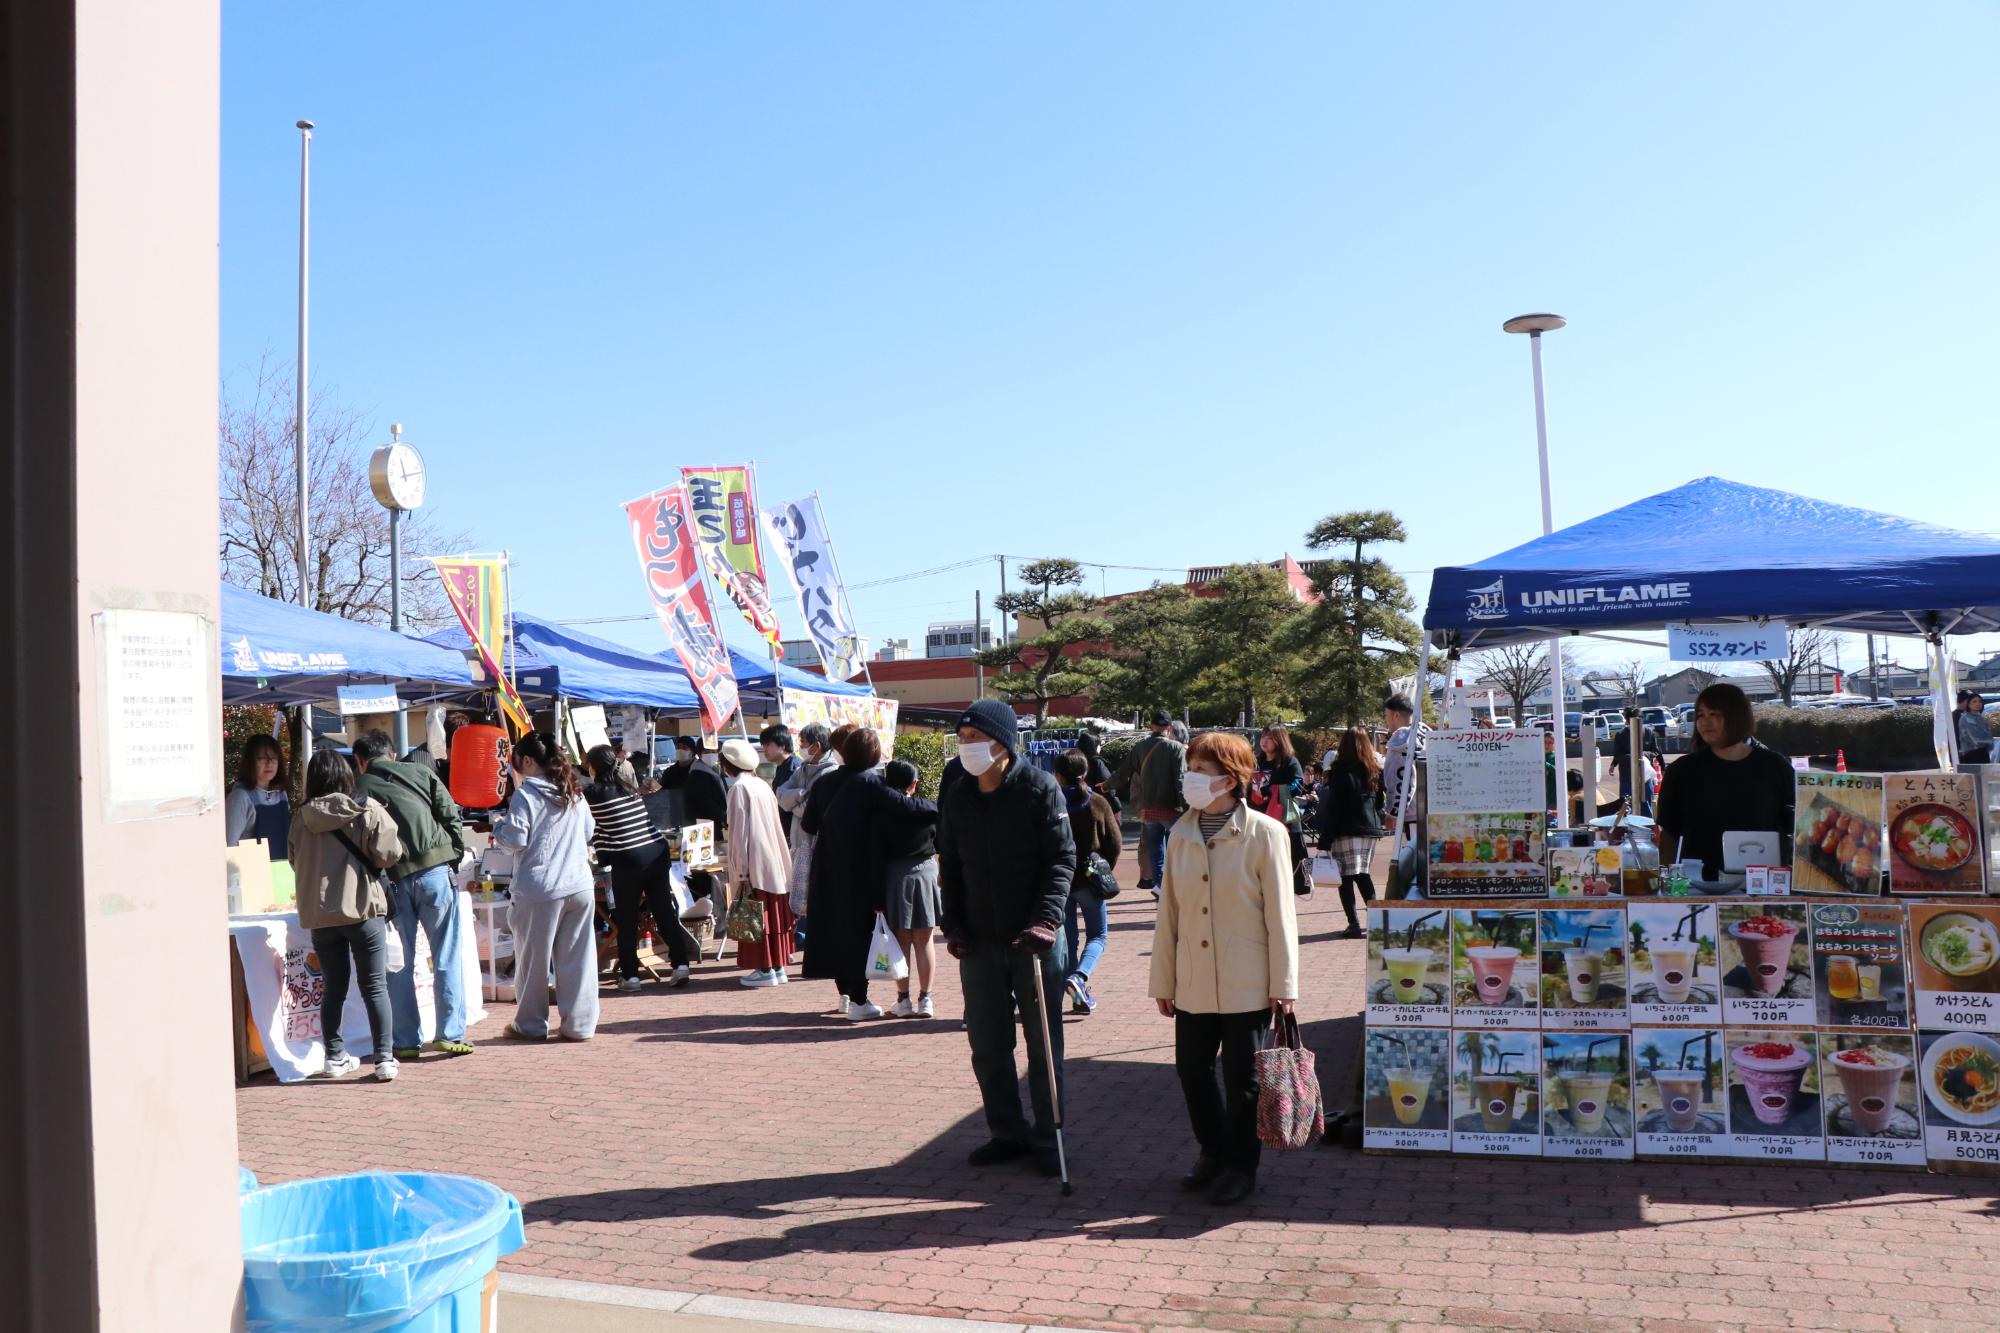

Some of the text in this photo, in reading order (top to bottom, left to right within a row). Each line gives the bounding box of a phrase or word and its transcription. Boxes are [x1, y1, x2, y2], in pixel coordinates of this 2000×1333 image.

[1521, 582, 1691, 607] UNIFLAME
[1545, 606, 1565, 614] want
[1579, 604, 1601, 612] make
[1603, 602, 1632, 611] friends
[1634, 601, 1652, 610] with
[1689, 640, 1767, 657] SSスタンド
[258, 651, 348, 666] UNIFLAME
[1904, 778, 1957, 792] とん汁
[1815, 928, 1896, 937] はちみつレモネード
[1815, 942, 1897, 952] はちみつレモネード
[1871, 953, 1899, 962] ソーダ
[1732, 1000, 1805, 1009] いちごスムージー
[1935, 995, 1992, 1008] かけうどん
[1645, 1004, 1708, 1013] いちご×バナナ豆乳
[1394, 1015, 1422, 1023] 500円
[1662, 1014, 1690, 1022] 600円
[1752, 1011, 1788, 1021] 700円
[1851, 1014, 1899, 1026] 各400円
[1943, 1012, 1987, 1025] 400円
[1483, 1018, 1508, 1026] 500円
[1573, 1019, 1598, 1027] 500円
[1395, 1139, 1419, 1147] 500円
[1460, 1134, 1531, 1143] キャラメル×カフェオレ
[1734, 1135, 1820, 1145] ベリーベリースムージー
[1484, 1144, 1510, 1152] 500円
[1827, 1138, 1922, 1149] いちごバナナスムージー
[1575, 1148, 1603, 1156] 600円
[1668, 1145, 1697, 1153] 600円
[1762, 1146, 1793, 1155] 700円
[1859, 1151, 1893, 1161] 700円
[1956, 1148, 1999, 1160] 500円
